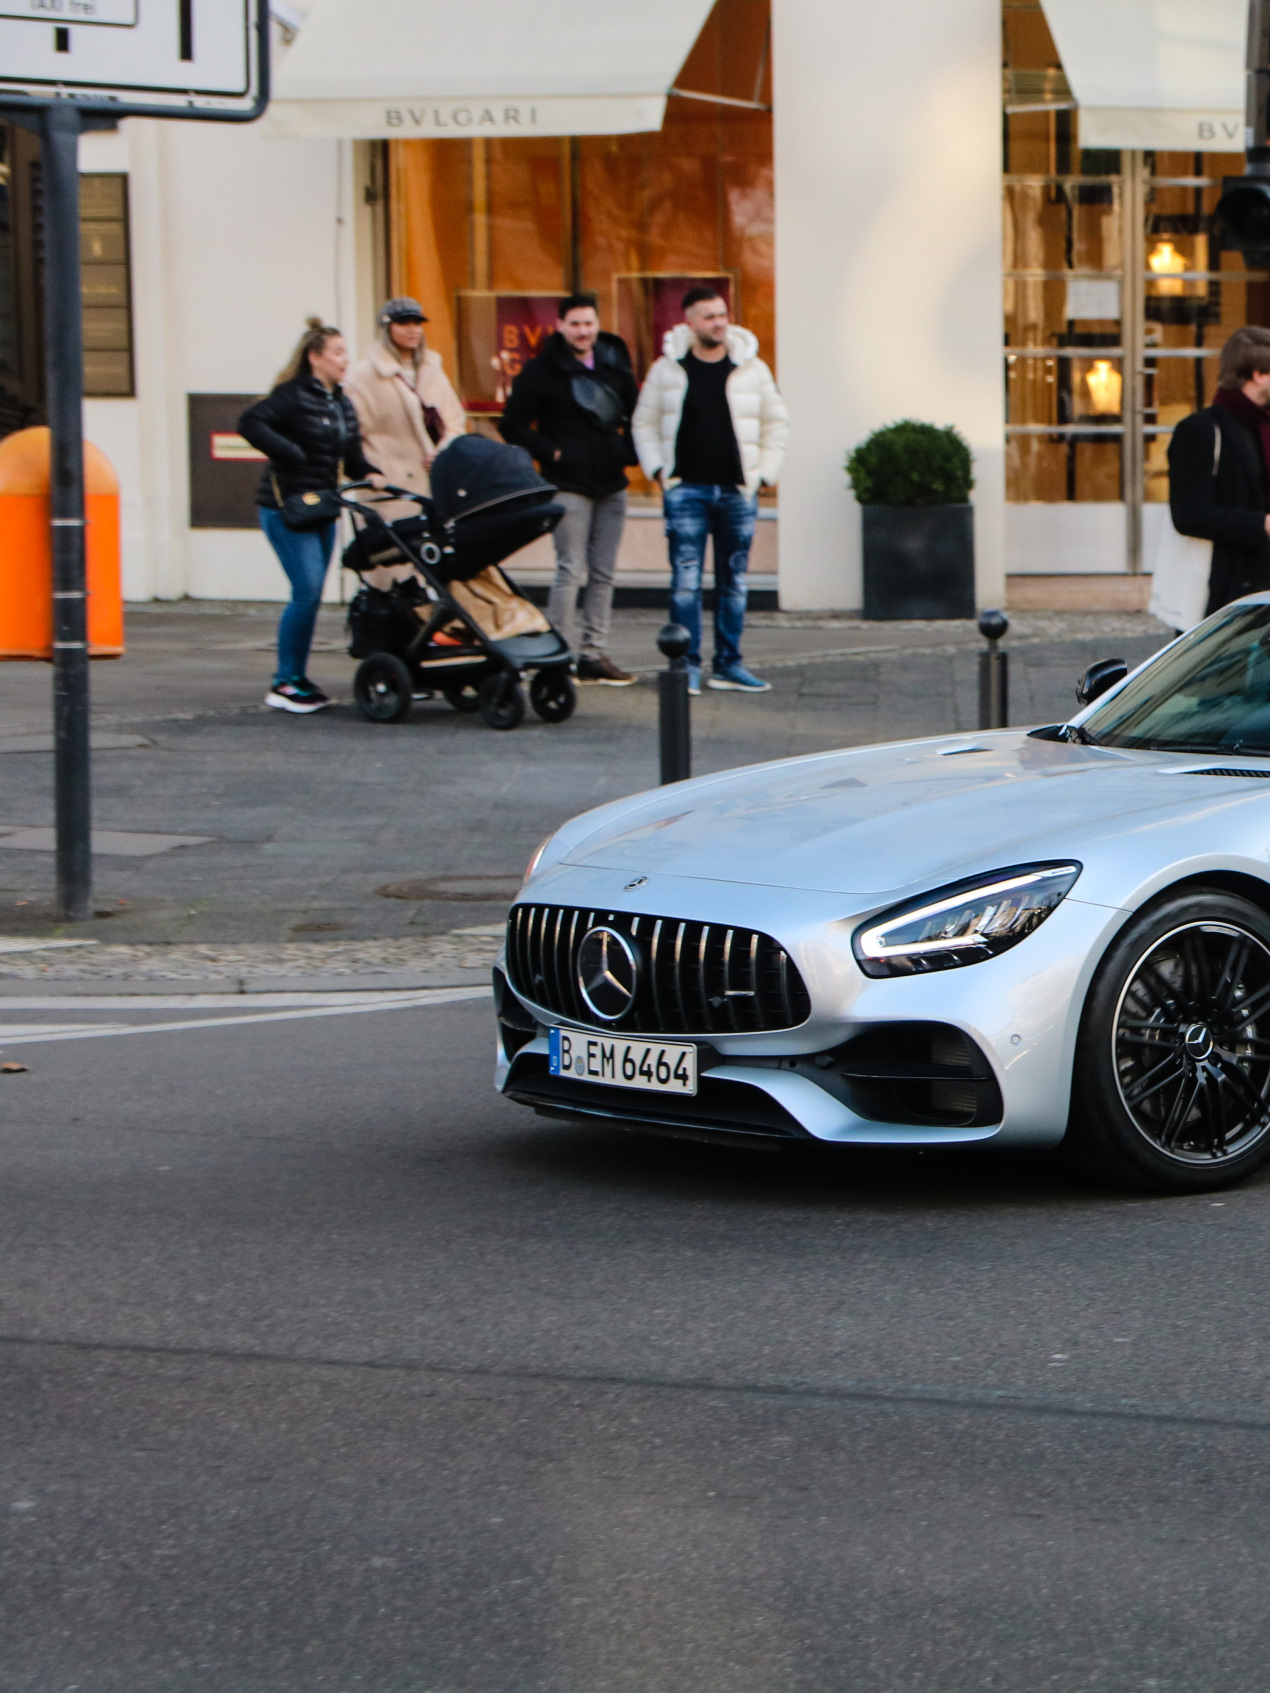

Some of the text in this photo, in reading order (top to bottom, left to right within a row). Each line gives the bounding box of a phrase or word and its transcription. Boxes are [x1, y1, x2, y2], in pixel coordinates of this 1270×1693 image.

[385, 106, 538, 128] BVLGARI
[561, 1035, 573, 1071] B
[622, 1045, 689, 1087] 6464
